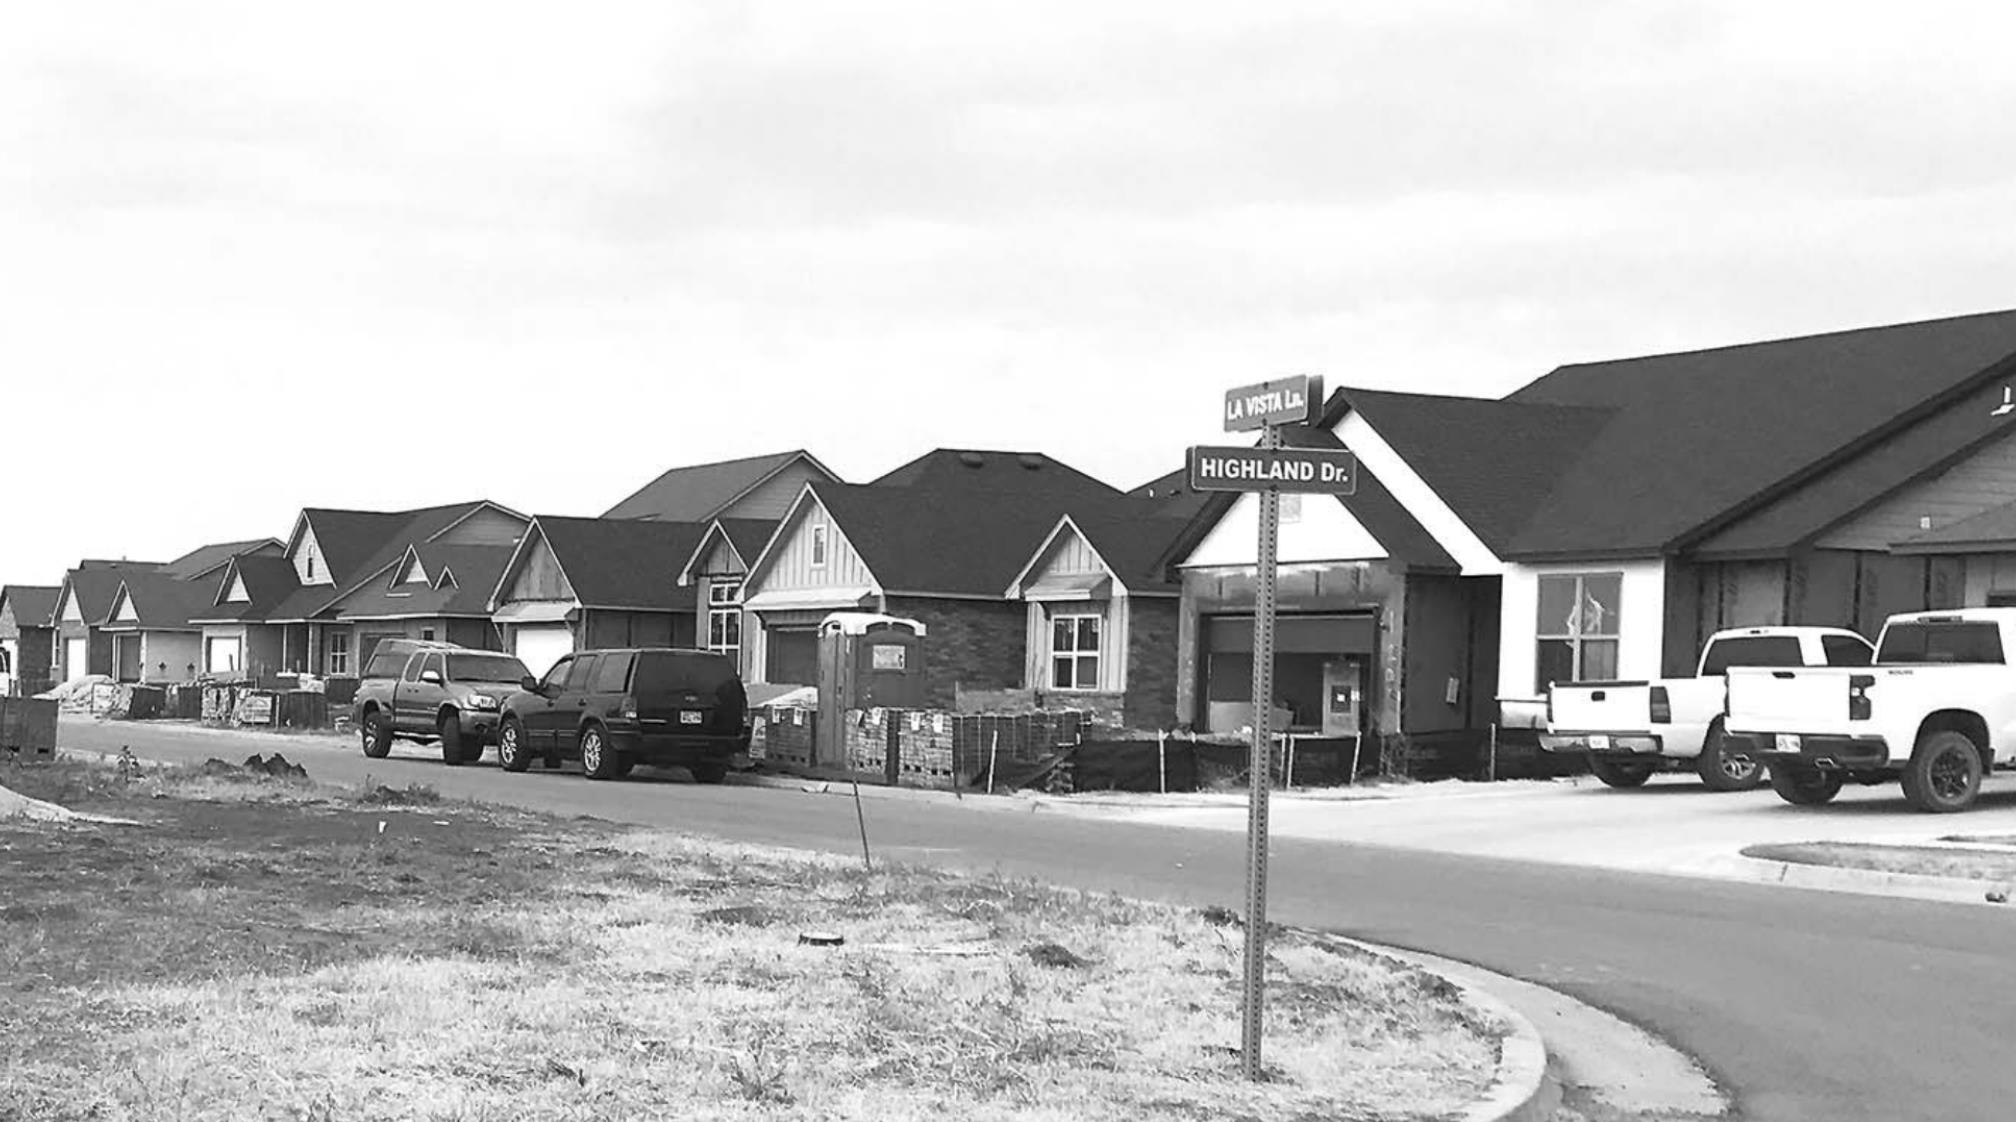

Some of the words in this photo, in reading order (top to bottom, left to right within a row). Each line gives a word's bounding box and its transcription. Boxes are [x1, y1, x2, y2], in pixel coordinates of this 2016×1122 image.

[1227, 399, 1244, 421] LA
[1245, 391, 1283, 417] VISTA
[1284, 389, 1304, 409] Ln.
[1201, 457, 1314, 481] HIGHLAND
[1320, 462, 1349, 482] Dr.
